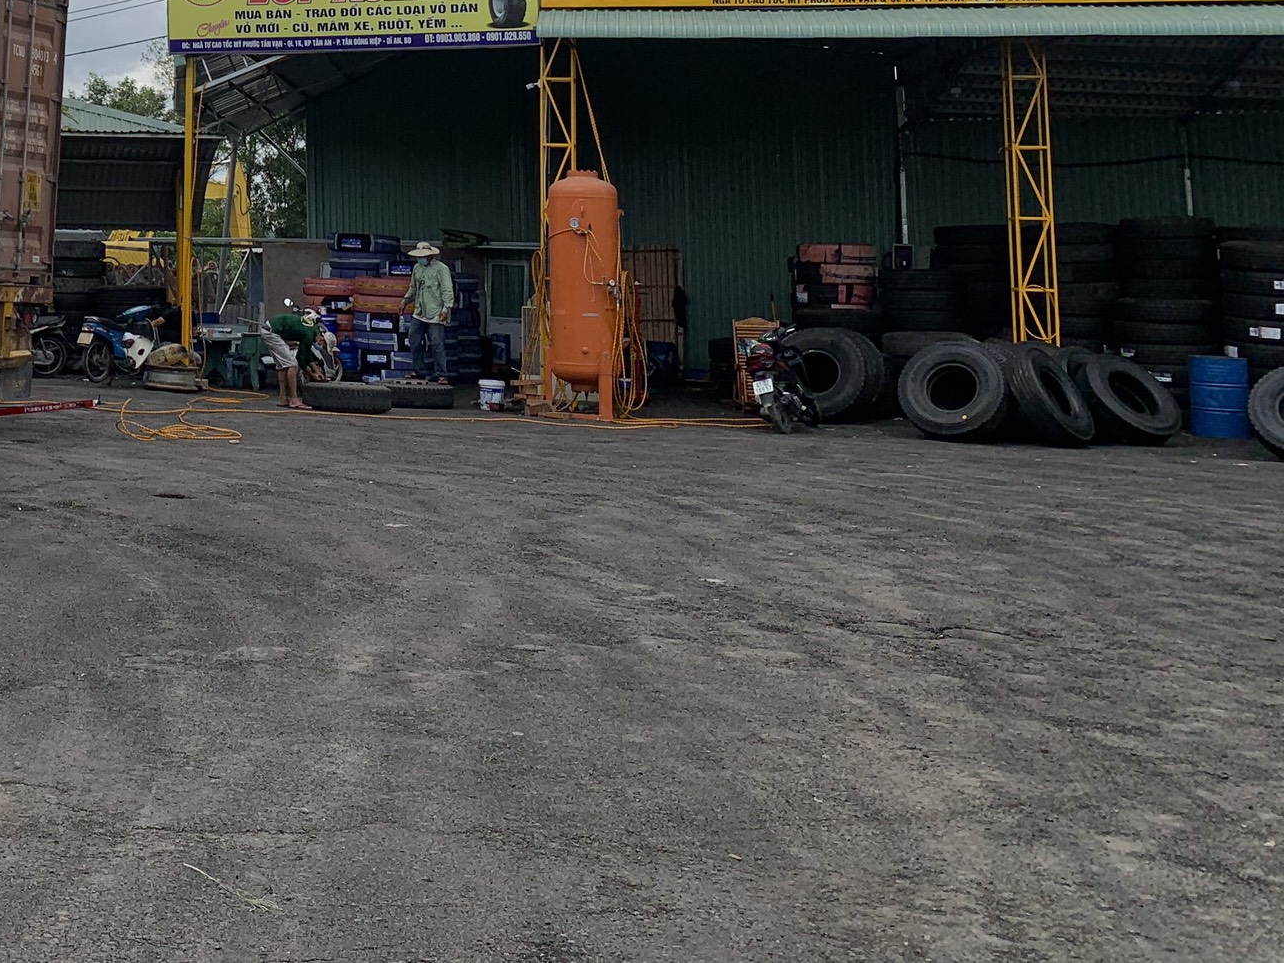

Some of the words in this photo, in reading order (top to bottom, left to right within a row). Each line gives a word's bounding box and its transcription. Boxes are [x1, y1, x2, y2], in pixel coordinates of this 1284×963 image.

[235, 10, 262, 20] MUA
[266, 8, 292, 19] BÁN
[304, 8, 336, 18] TRAO
[340, 3, 361, 17] ĐỔI
[366, 4, 391, 16] CÁC
[397, 4, 425, 17] LOẠI
[430, 1, 446, 14] VỎ
[450, 1, 478, 14] DÁN
[235, 20, 251, 34] VỎ
[256, 22, 280, 34] MỚI
[292, 21, 313, 34] CŨ,
[317, 20, 349, 32] MÂM
[353, 20, 374, 32] XE,
[378, 19, 414, 32] RUỘT,
[418, 15, 446, 29] YẾM
